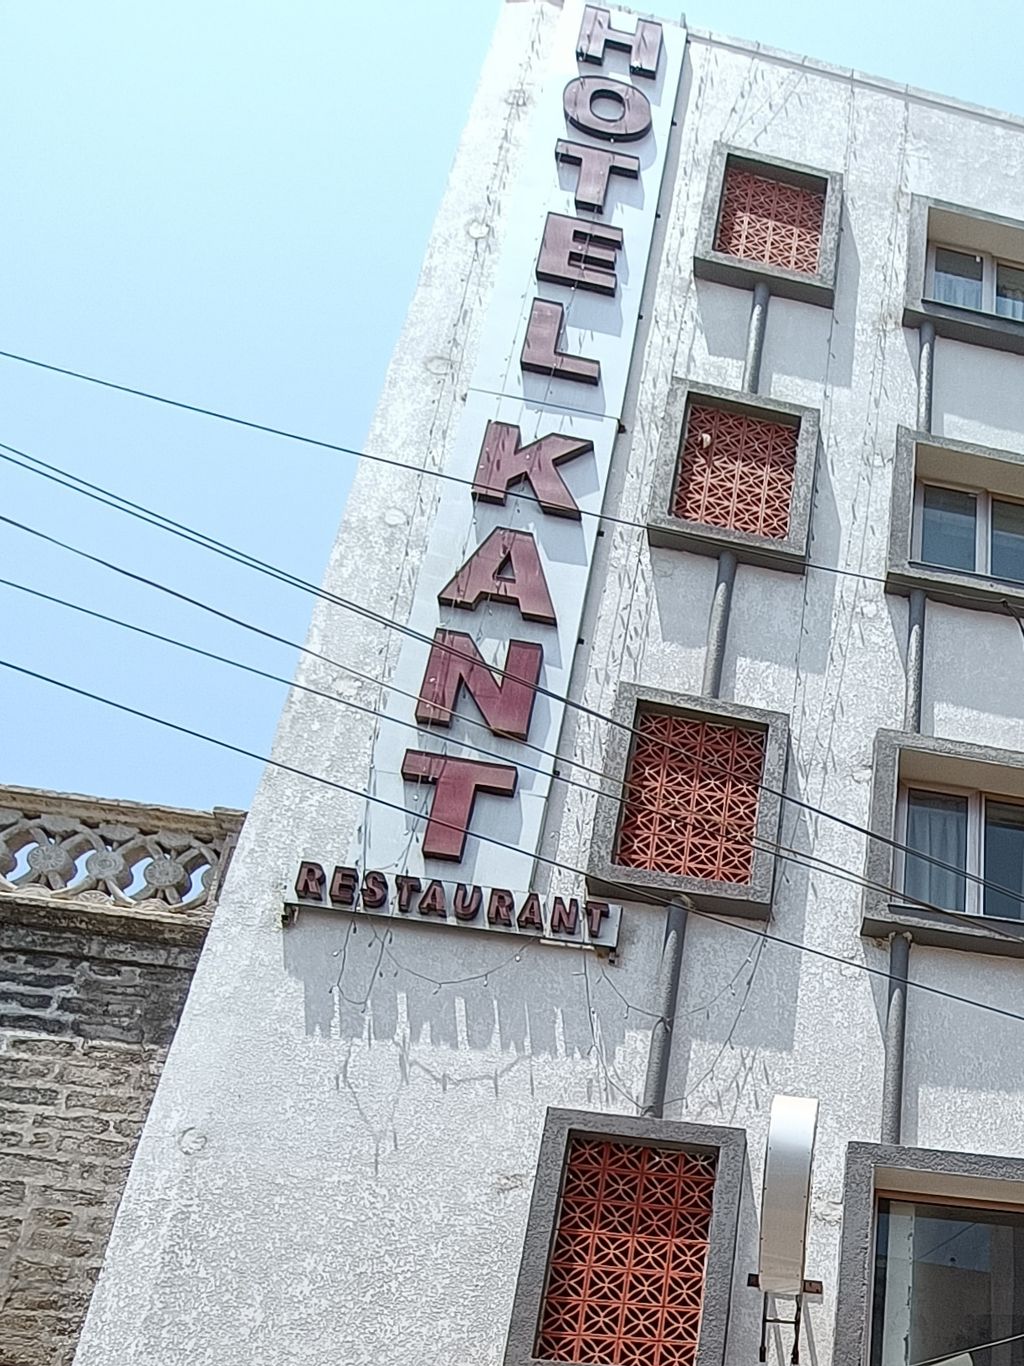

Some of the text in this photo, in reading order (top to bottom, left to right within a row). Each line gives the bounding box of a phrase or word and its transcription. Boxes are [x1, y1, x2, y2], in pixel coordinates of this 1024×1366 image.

[521, 4, 664, 386] HOTEL
[400, 419, 596, 864] KANT
[294, 860, 611, 938] RESTAURANT
